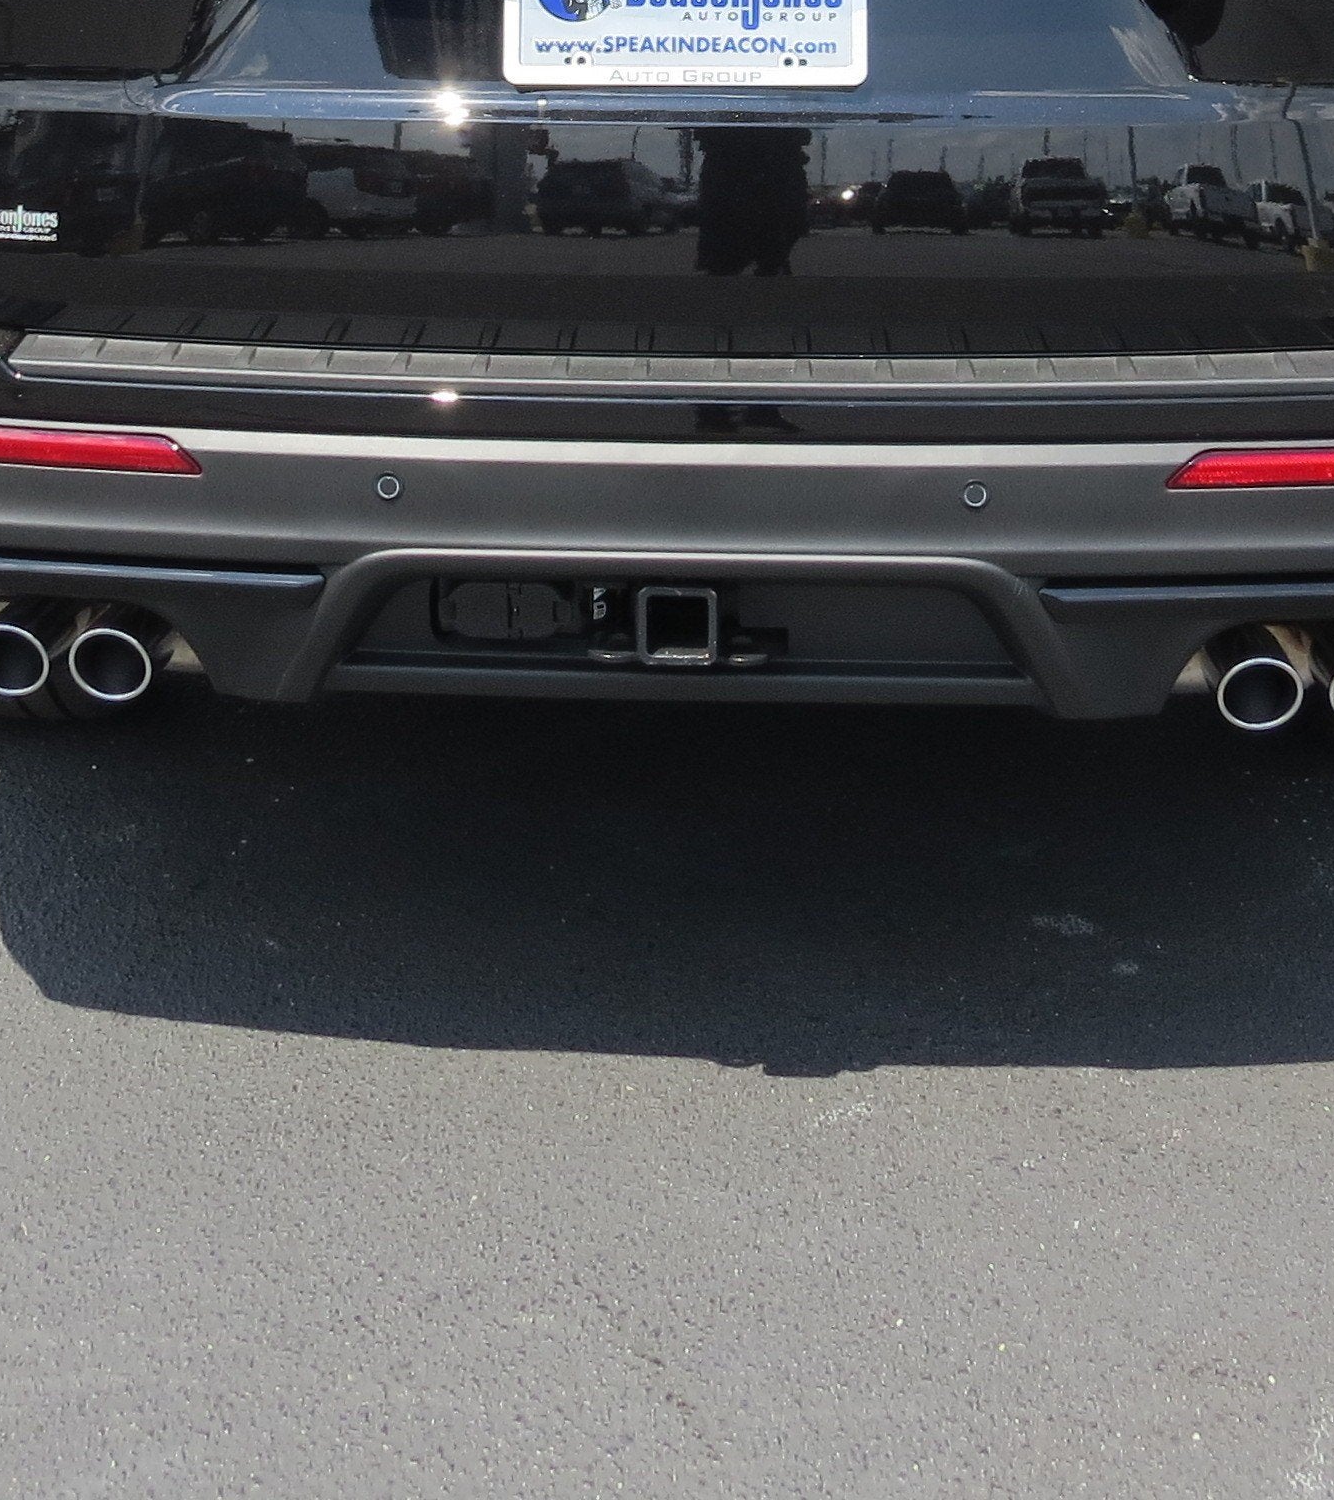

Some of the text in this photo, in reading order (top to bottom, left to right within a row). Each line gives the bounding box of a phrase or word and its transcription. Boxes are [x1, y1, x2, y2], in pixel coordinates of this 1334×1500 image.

[682, 11, 839, 22] AUTO GROUP
[534, 36, 837, 54] www.SPEAKINDEACON.com
